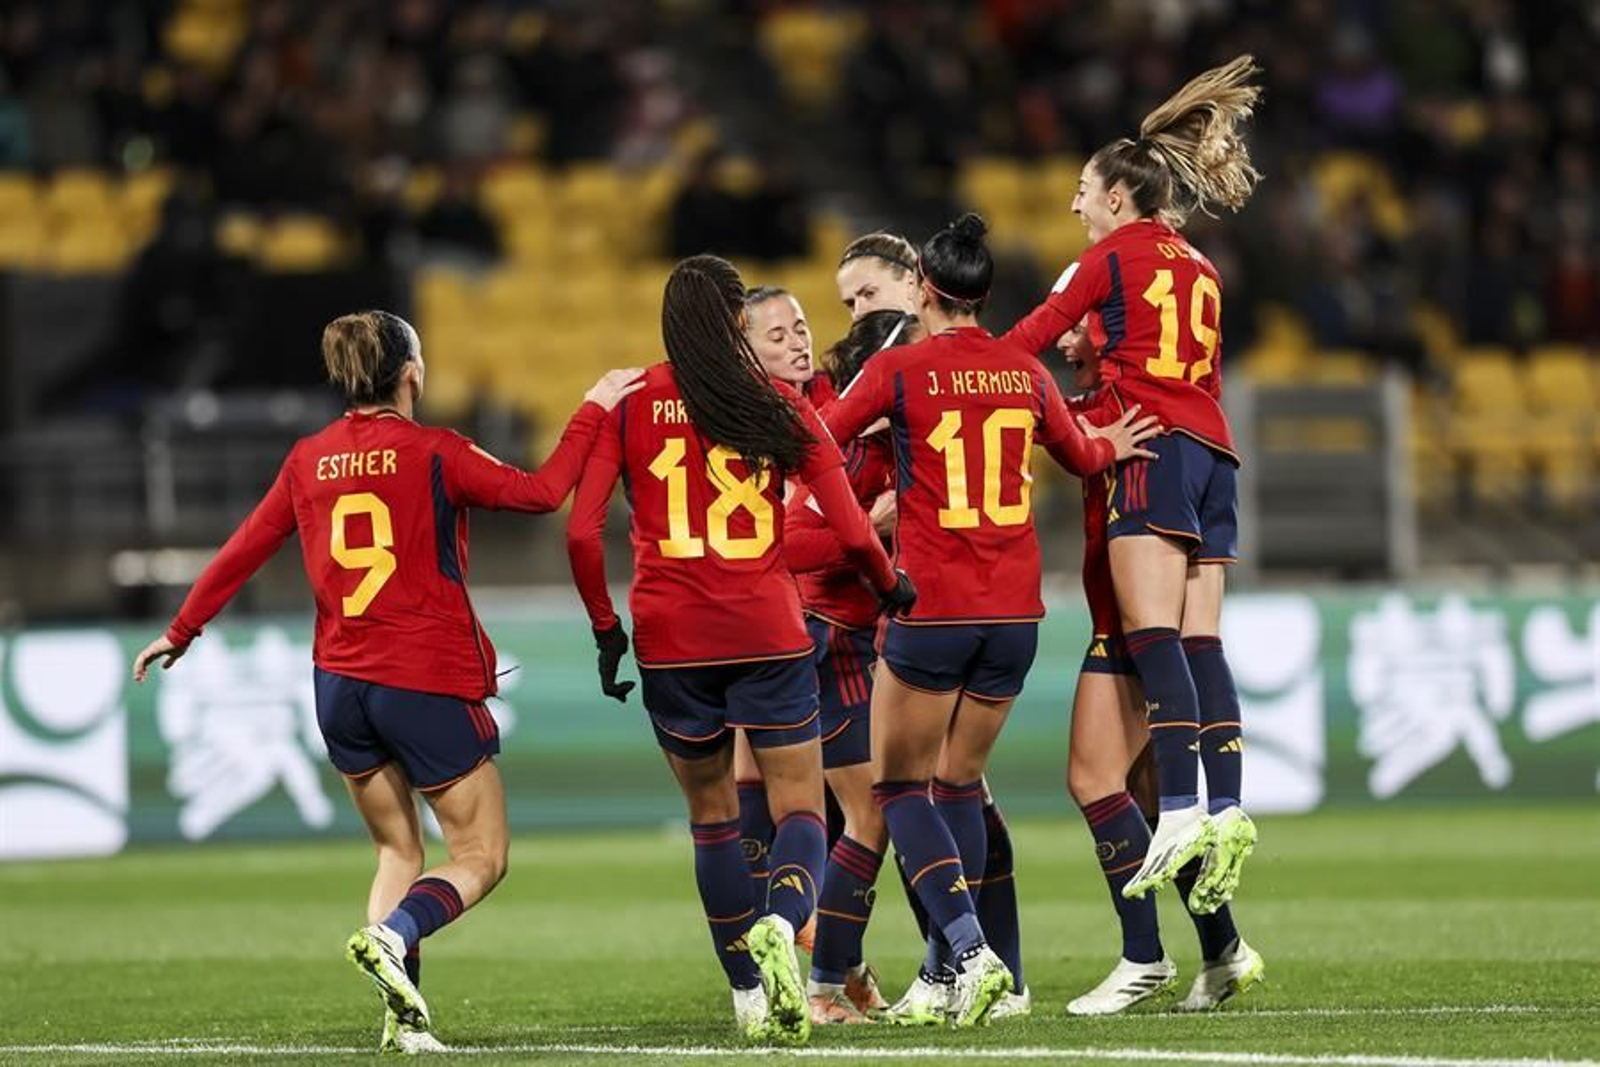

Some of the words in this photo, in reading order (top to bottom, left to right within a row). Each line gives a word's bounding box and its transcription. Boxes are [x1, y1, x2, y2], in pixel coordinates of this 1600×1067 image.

[927, 371, 945, 396] J.
[952, 371, 1032, 394] HERMOSO
[1142, 268, 1222, 384] 19
[316, 448, 397, 481] ESTHER
[652, 399, 689, 424] PAR
[926, 409, 1034, 529] 10
[330, 493, 397, 617] 9
[648, 438, 774, 560] 18
